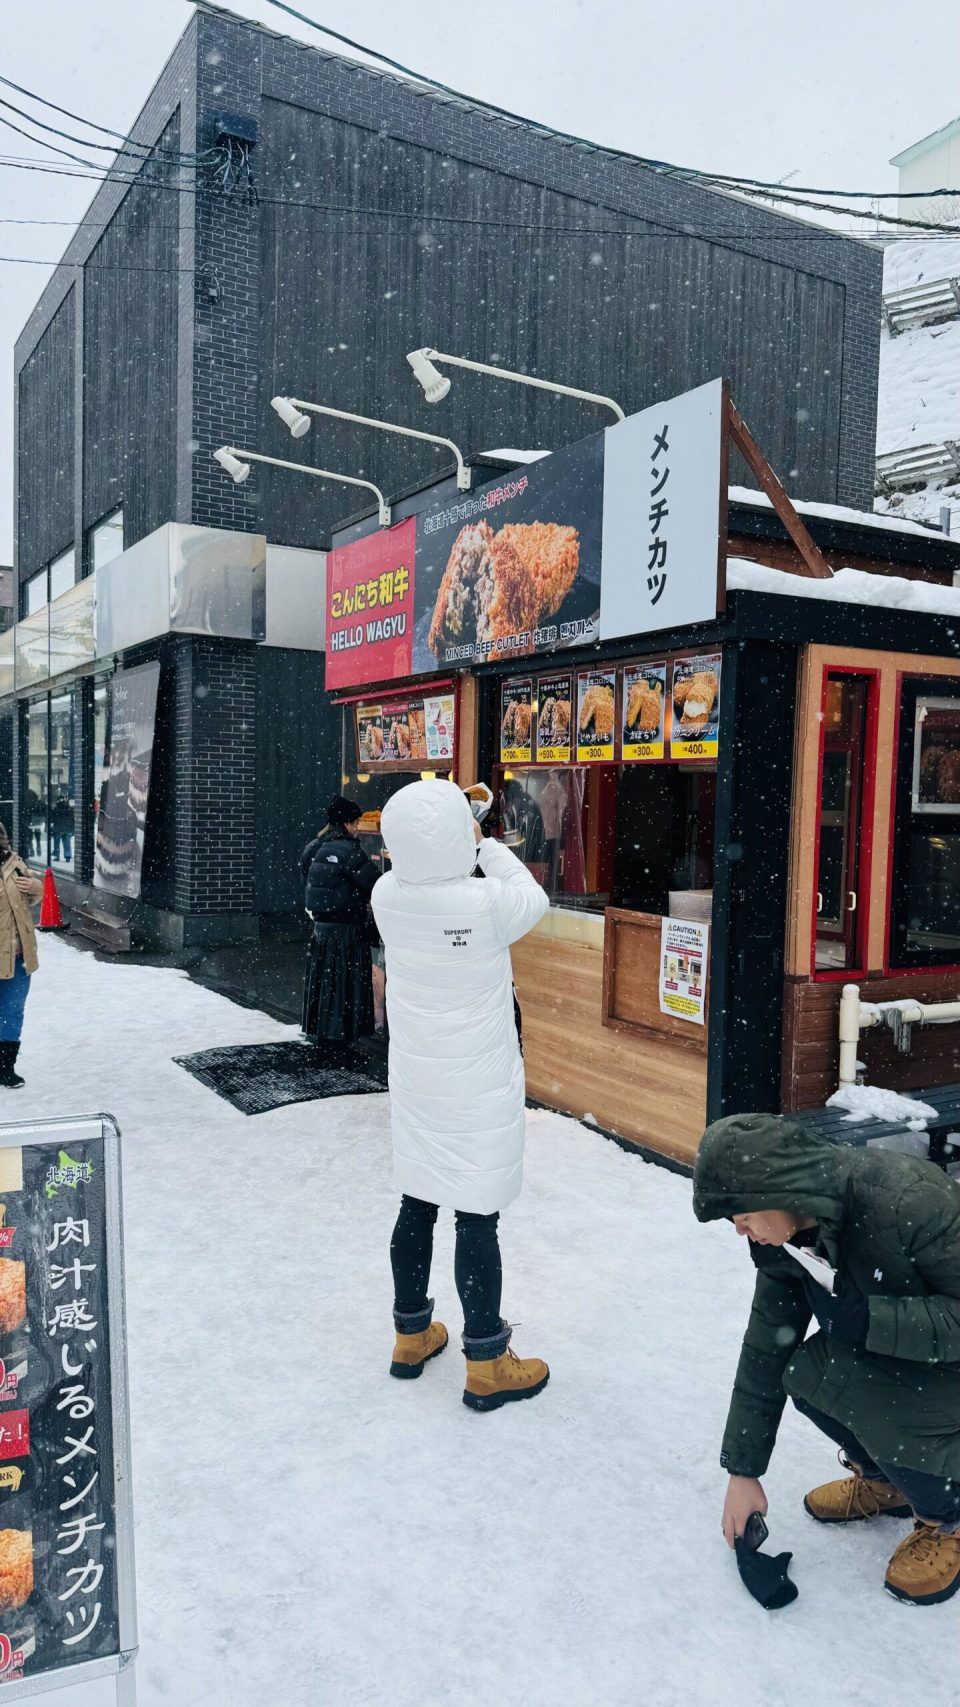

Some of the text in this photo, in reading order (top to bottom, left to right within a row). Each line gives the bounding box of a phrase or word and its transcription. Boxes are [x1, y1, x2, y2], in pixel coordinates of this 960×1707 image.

[647, 424, 670, 606] メンチカツ
[331, 566, 409, 619] こんにち和牛
[331, 613, 406, 652] HELLO WAGYU
[445, 643, 474, 662] MINCED
[475, 639, 495, 655] BEEF
[497, 632, 530, 651] CUTLET
[560, 618, 594, 639] 멘치까스
[630, 730, 657, 740] かぼちゃ
[674, 726, 716, 740] カニクリーム
[672, 924, 697, 936] CAUTION
[46, 1163, 92, 1185] 北海道
[46, 1216, 106, 1646] 肉汁感じるメンチカツ
